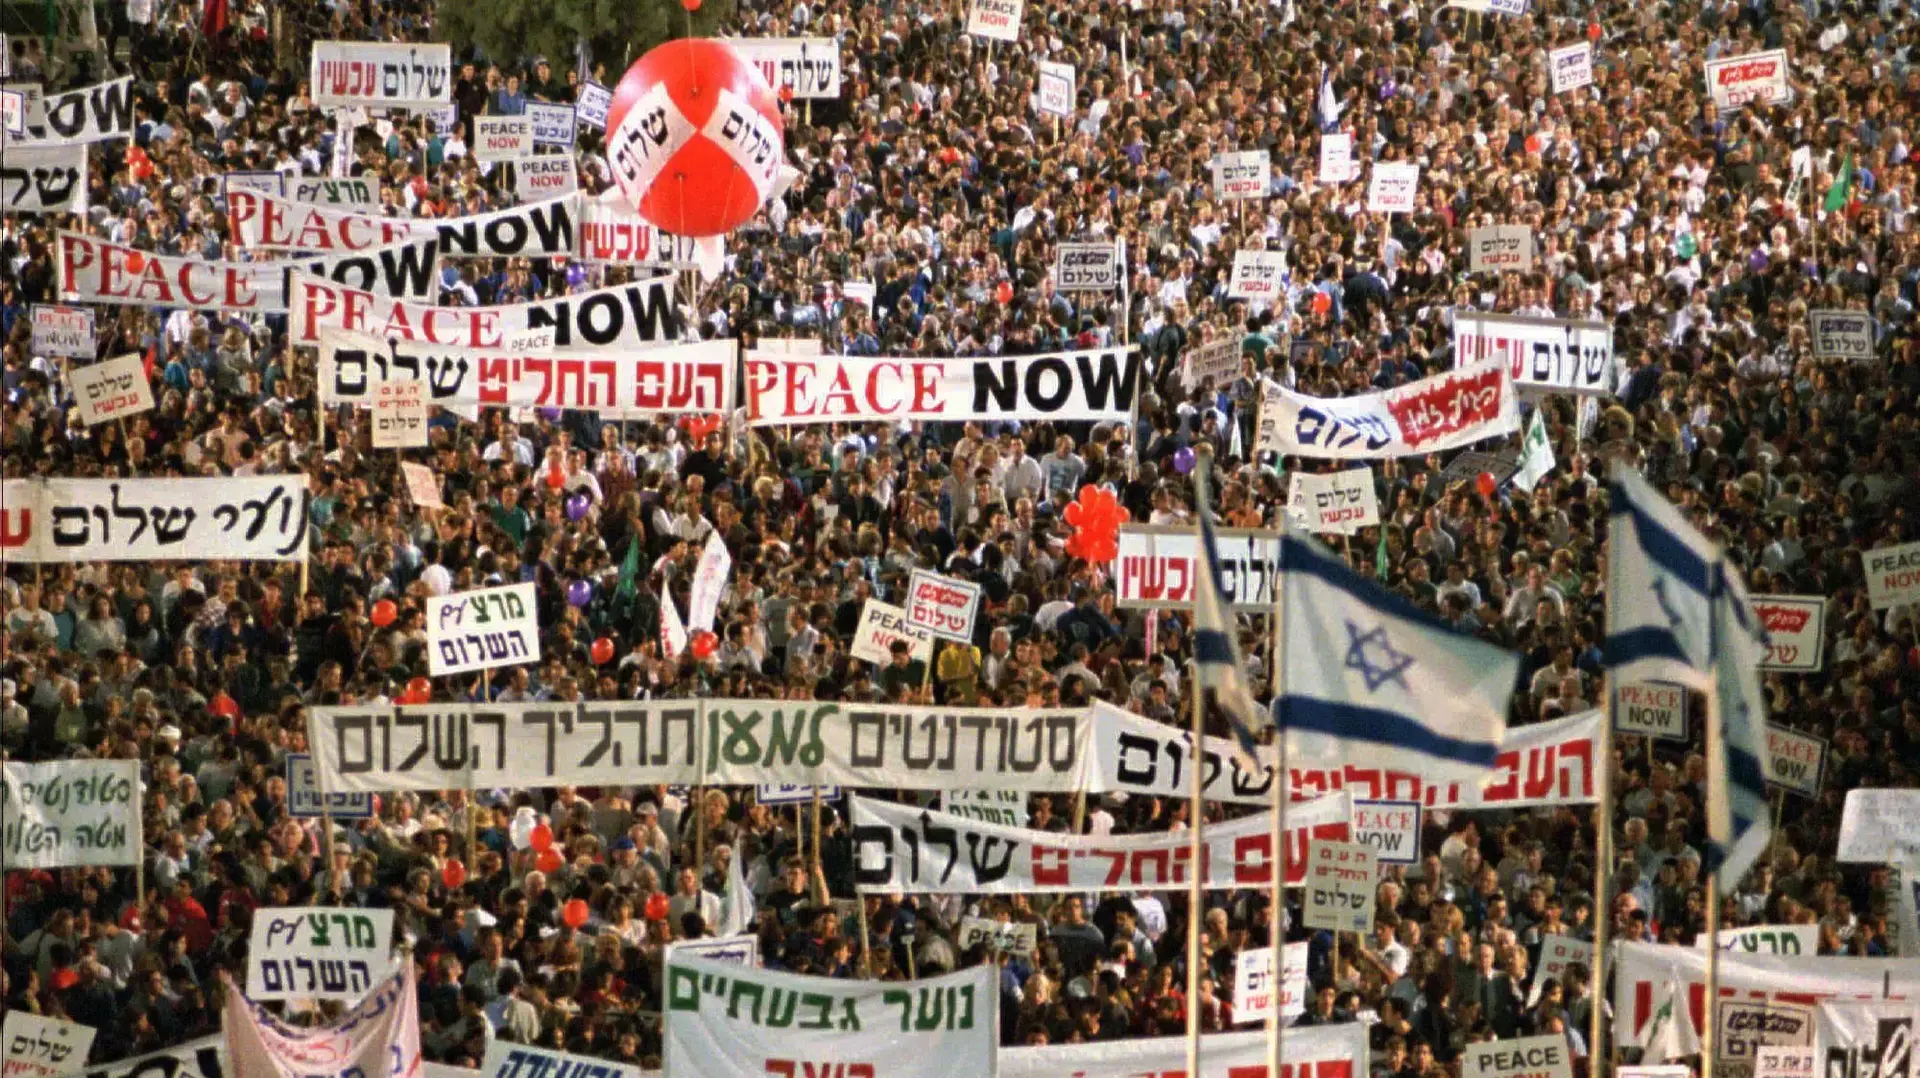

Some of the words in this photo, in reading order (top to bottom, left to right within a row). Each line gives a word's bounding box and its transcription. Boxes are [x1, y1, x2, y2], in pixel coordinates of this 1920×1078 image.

[980, 14, 1009, 27] NOW
[319, 61, 376, 95] עכשיו
[382, 49, 447, 97] שלום
[781, 43, 833, 91] שלום
[480, 122, 528, 136] PEACE
[532, 108, 568, 124] שלום
[532, 125, 570, 139] עכשי
[487, 137, 520, 149] NOW
[616, 106, 668, 181] שלום
[722, 109, 773, 164] שלום
[522, 160, 570, 175] PEACE
[530, 175, 564, 188] NOW
[1223, 158, 1260, 179] שלום
[323, 181, 371, 203] מרצ
[1224, 180, 1261, 193] עכשיו
[229, 190, 410, 249] PEACE
[438, 201, 573, 254] NOW
[580, 222, 650, 261] עכשיו
[1481, 237, 1520, 252] שלום
[61, 235, 257, 306] PEACE
[1063, 267, 1109, 283] שלום
[1240, 257, 1275, 278] שלום
[302, 283, 500, 348] PEACE
[528, 284, 678, 345] NOW
[511, 336, 549, 351] PEACE
[1533, 324, 1607, 384] שלום
[1822, 333, 1865, 351] שלום
[86, 370, 133, 399] שלום
[335, 338, 468, 398] שלום
[478, 357, 616, 407] החליט
[635, 361, 723, 409] העם
[747, 361, 945, 420] PEACE
[972, 351, 1140, 413] NOW
[93, 392, 139, 415] עכשיו
[379, 410, 420, 430] שלום
[1295, 405, 1392, 450] שלום
[1315, 480, 1361, 507] שלום
[51, 483, 197, 546] שלום
[1321, 506, 1365, 525] עכשיו
[470, 591, 525, 623] מרצ
[913, 604, 966, 631] שלום
[438, 630, 529, 667] השלום
[1620, 686, 1679, 710] PEACE
[1628, 706, 1671, 729] NOW
[333, 706, 507, 774] השלום
[523, 703, 695, 777] תהליך
[707, 704, 839, 774] למען
[850, 712, 1077, 773] סטודנטים
[1765, 730, 1816, 764] EACE
[22, 769, 131, 814] סטודנטים
[1289, 764, 1458, 805] חליט
[853, 811, 1019, 885] שלום
[1313, 883, 1366, 909] שלום
[308, 913, 376, 948] מרצ
[262, 957, 371, 993] השלום
[669, 965, 861, 1032] גבעתיים
[884, 984, 975, 1032] נוער
[11, 1028, 73, 1062] שלום
[1478, 1047, 1559, 1072] PEACE
